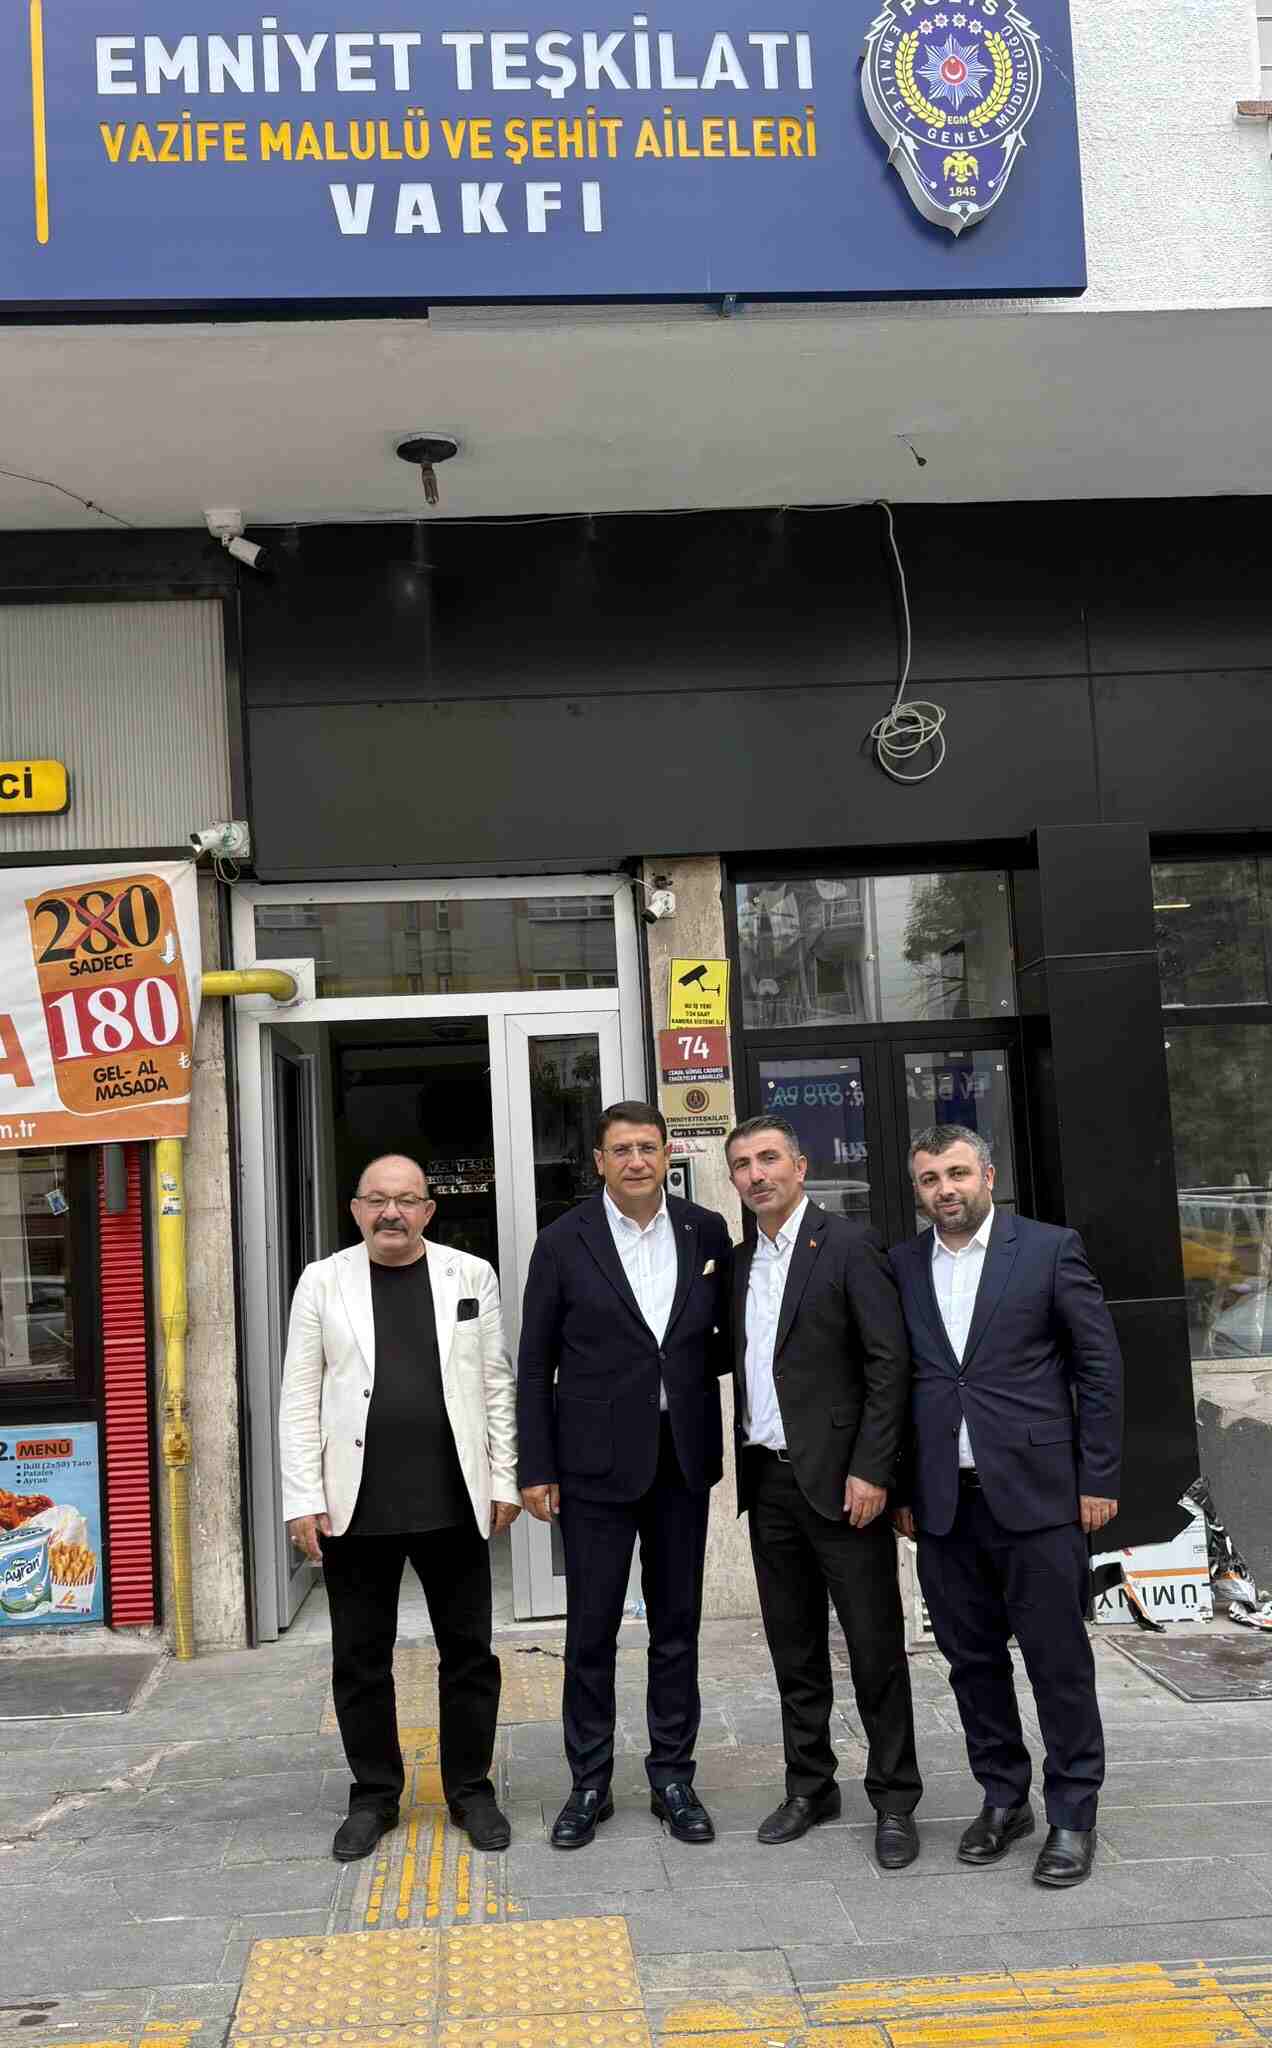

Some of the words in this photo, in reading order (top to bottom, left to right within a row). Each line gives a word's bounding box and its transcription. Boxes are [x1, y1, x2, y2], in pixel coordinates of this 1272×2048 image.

[96, 16, 422, 95] EMNİYET
[441, 13, 814, 99] TEŞKİLATI
[100, 110, 248, 163] VAZİFE
[260, 106, 431, 161] MALULÜ
[441, 119, 493, 160] VE
[504, 105, 624, 165] ŞEHİT
[634, 106, 817, 159] AİLELERİ
[926, 127, 990, 145] GENEL
[948, 186, 977, 198] 1845
[329, 181, 603, 236] VAKFI
[33, 883, 161, 965] 280
[68, 953, 134, 977] SADECE
[48, 976, 182, 1062] 180
[678, 1035, 710, 1061] 74
[137, 1060, 158, 1077] AL
[95, 1075, 169, 1101] MASADA
[20, 1439, 71, 1457] MENÜ
[5, 1556, 40, 1583] Ayran
